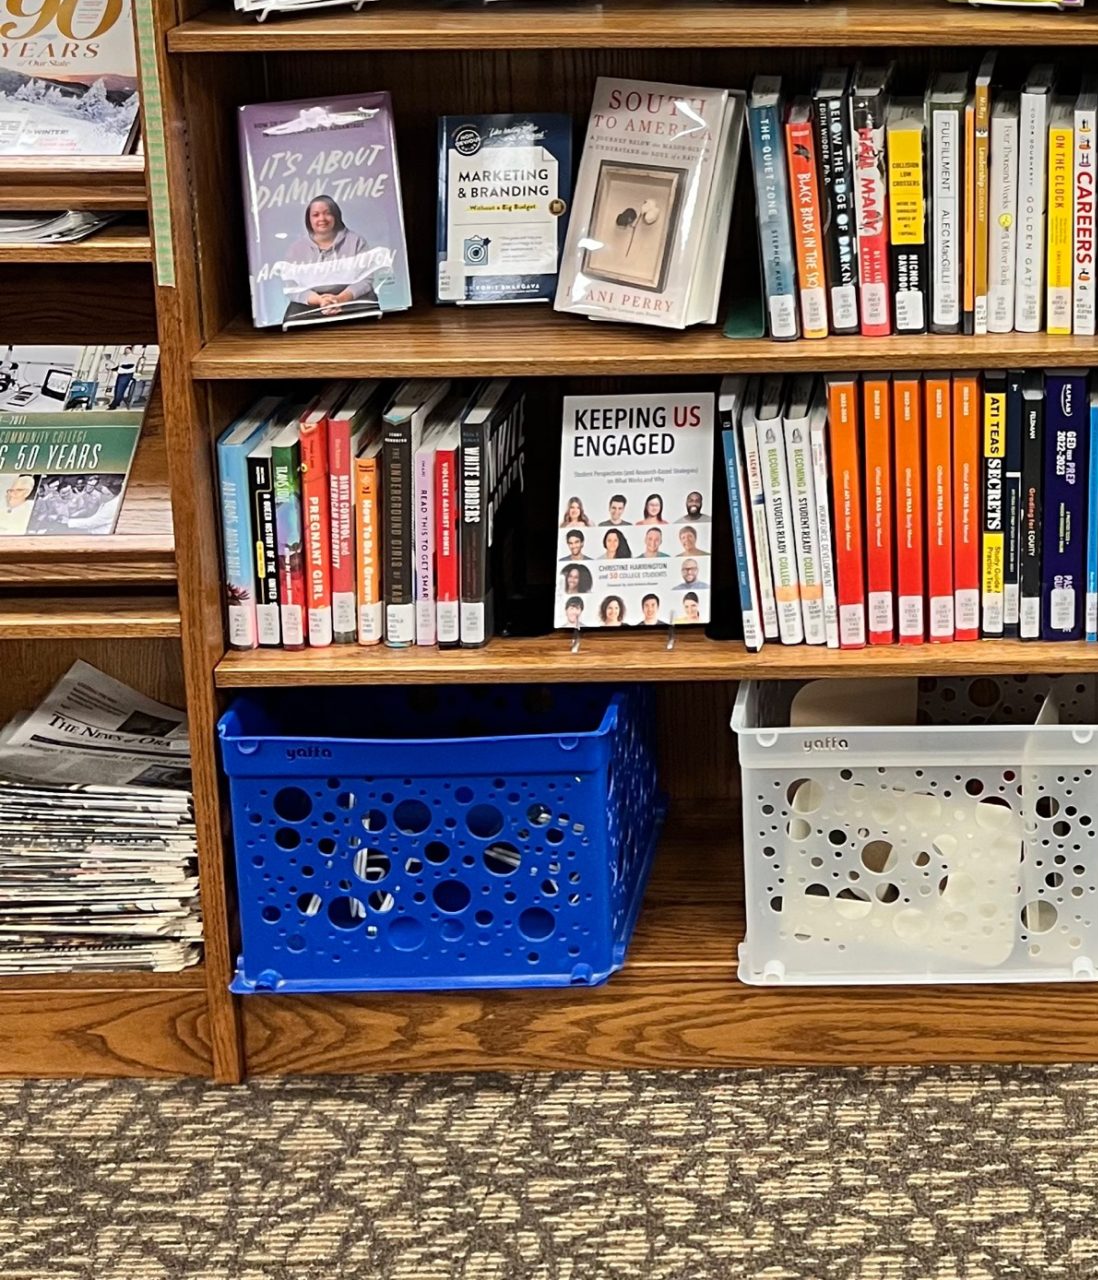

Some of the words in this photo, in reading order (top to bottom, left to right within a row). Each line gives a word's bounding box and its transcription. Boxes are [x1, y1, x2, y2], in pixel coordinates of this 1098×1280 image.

[260, 152, 302, 181] IT'S
[307, 144, 384, 174] ABOUT
[458, 168, 548, 182] MARKETING
[458, 188, 467, 198] &
[470, 185, 549, 197] BRANDING
[1077, 172, 1093, 263] CAREERS
[574, 407, 666, 430] KEEPING
[673, 406, 701, 427] US
[990, 397, 1000, 415] ATI
[573, 433, 674, 457] ENGAGED
[990, 422, 1000, 453] TEAS
[15, 445, 38, 469] 50
[47, 444, 102, 469] YEARS
[464, 447, 480, 476] WHITE
[464, 480, 481, 523] BORDERS
[988, 458, 1001, 529] SECRETS
[309, 496, 321, 574] PREGNANT
[312, 578, 324, 600] GIRL
[286, 746, 332, 761] yaffa
[804, 737, 849, 752] yaffa
